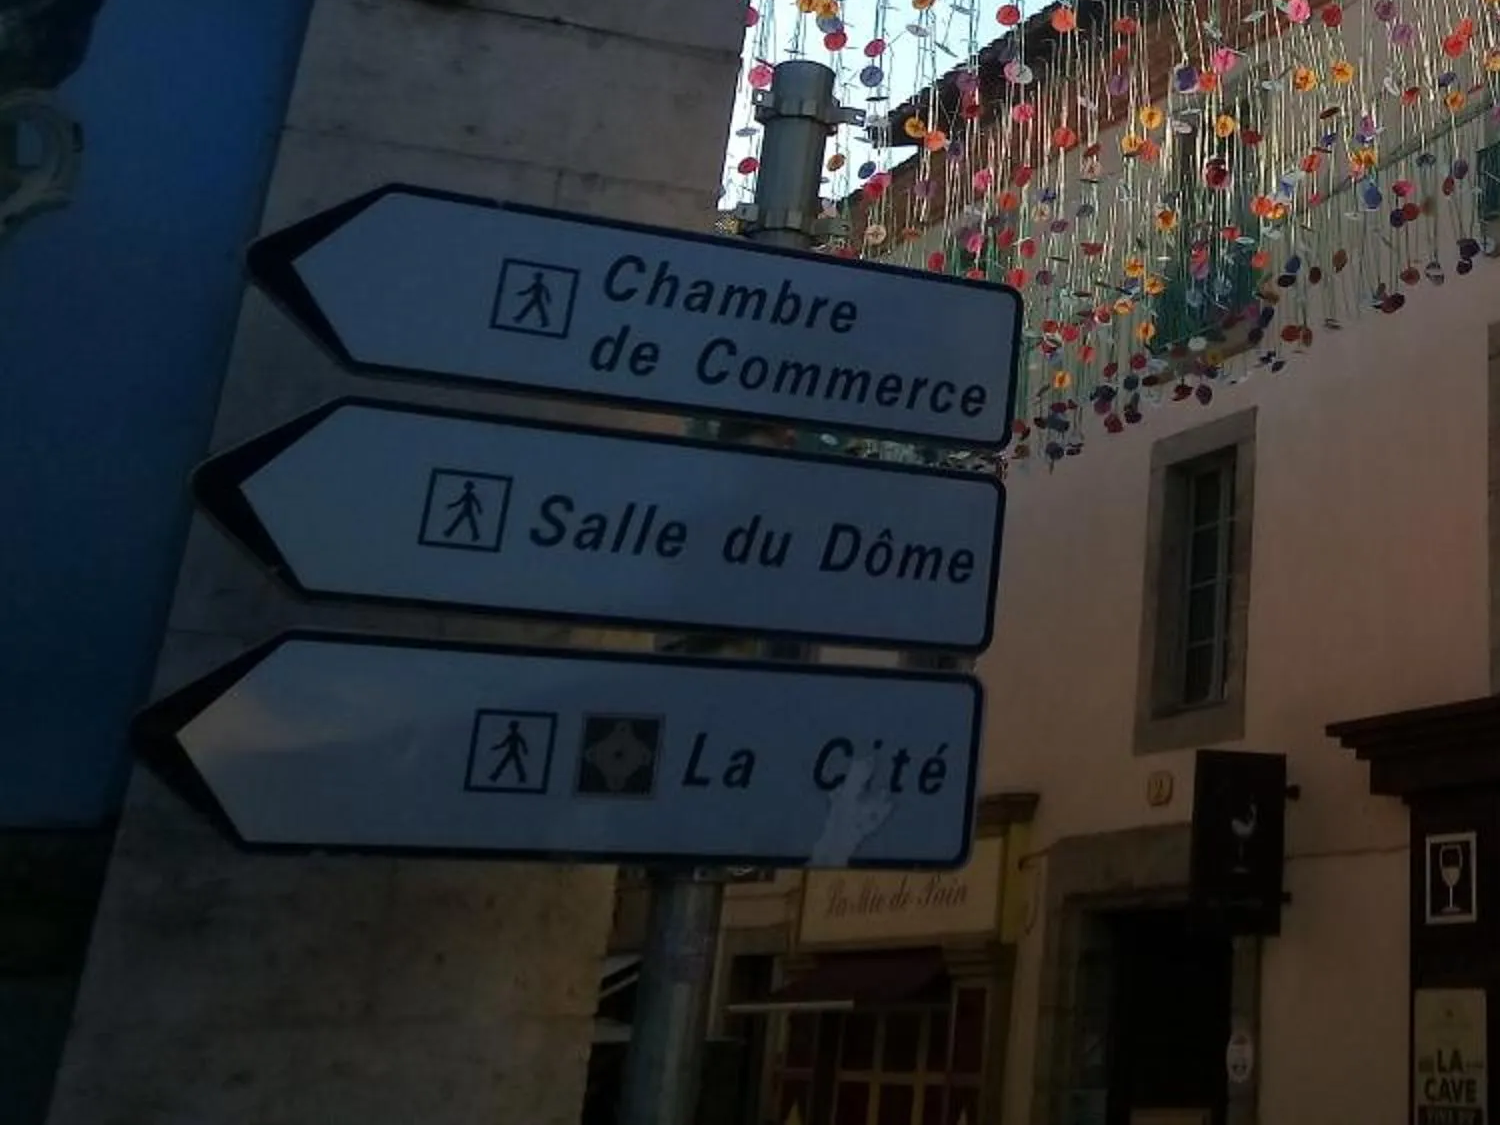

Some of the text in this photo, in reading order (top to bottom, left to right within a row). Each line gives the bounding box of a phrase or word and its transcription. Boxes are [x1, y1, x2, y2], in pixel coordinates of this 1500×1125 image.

[602, 254, 859, 336] Chambre
[590, 325, 990, 418] de Commerce
[530, 493, 978, 586] Salle du Dôme
[682, 732, 755, 791] La
[1424, 1077, 1478, 1104] CAVE
[1437, 1048, 1463, 1073] LA
